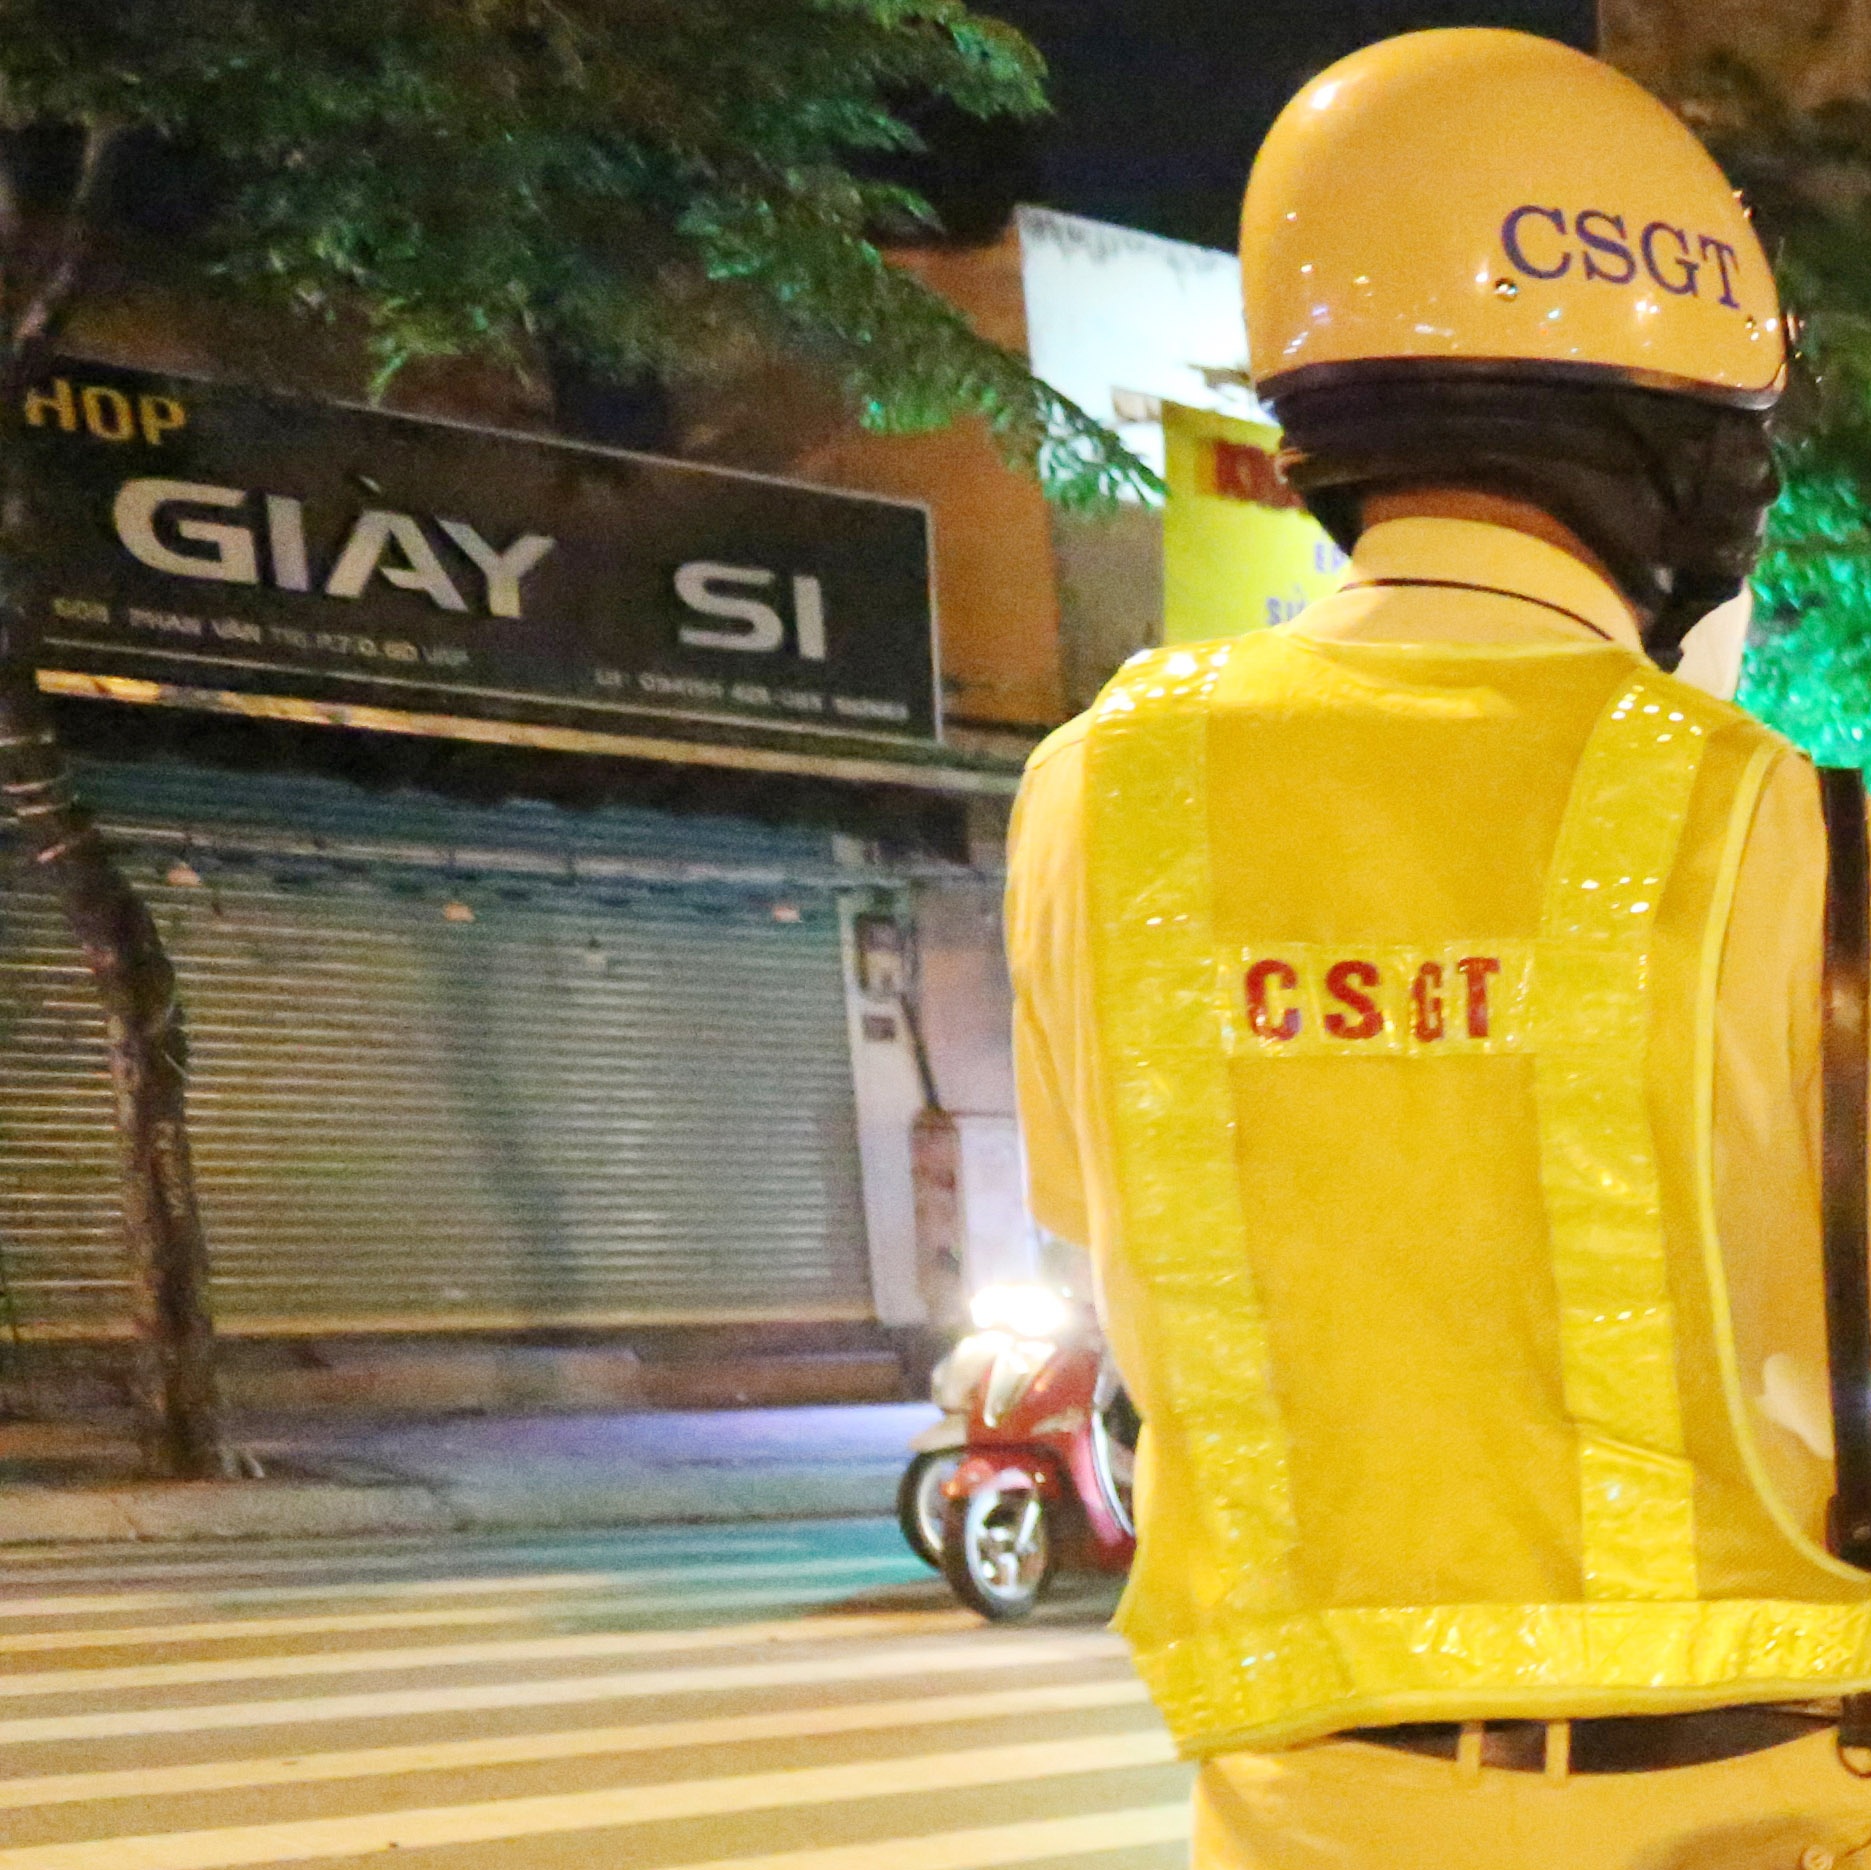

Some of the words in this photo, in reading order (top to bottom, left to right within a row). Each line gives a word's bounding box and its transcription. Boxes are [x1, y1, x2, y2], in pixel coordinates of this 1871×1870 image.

[1501, 204, 1741, 310] CSGT
[113, 474, 557, 620] GIÀY
[1245, 956, 1500, 1043] CSGT
